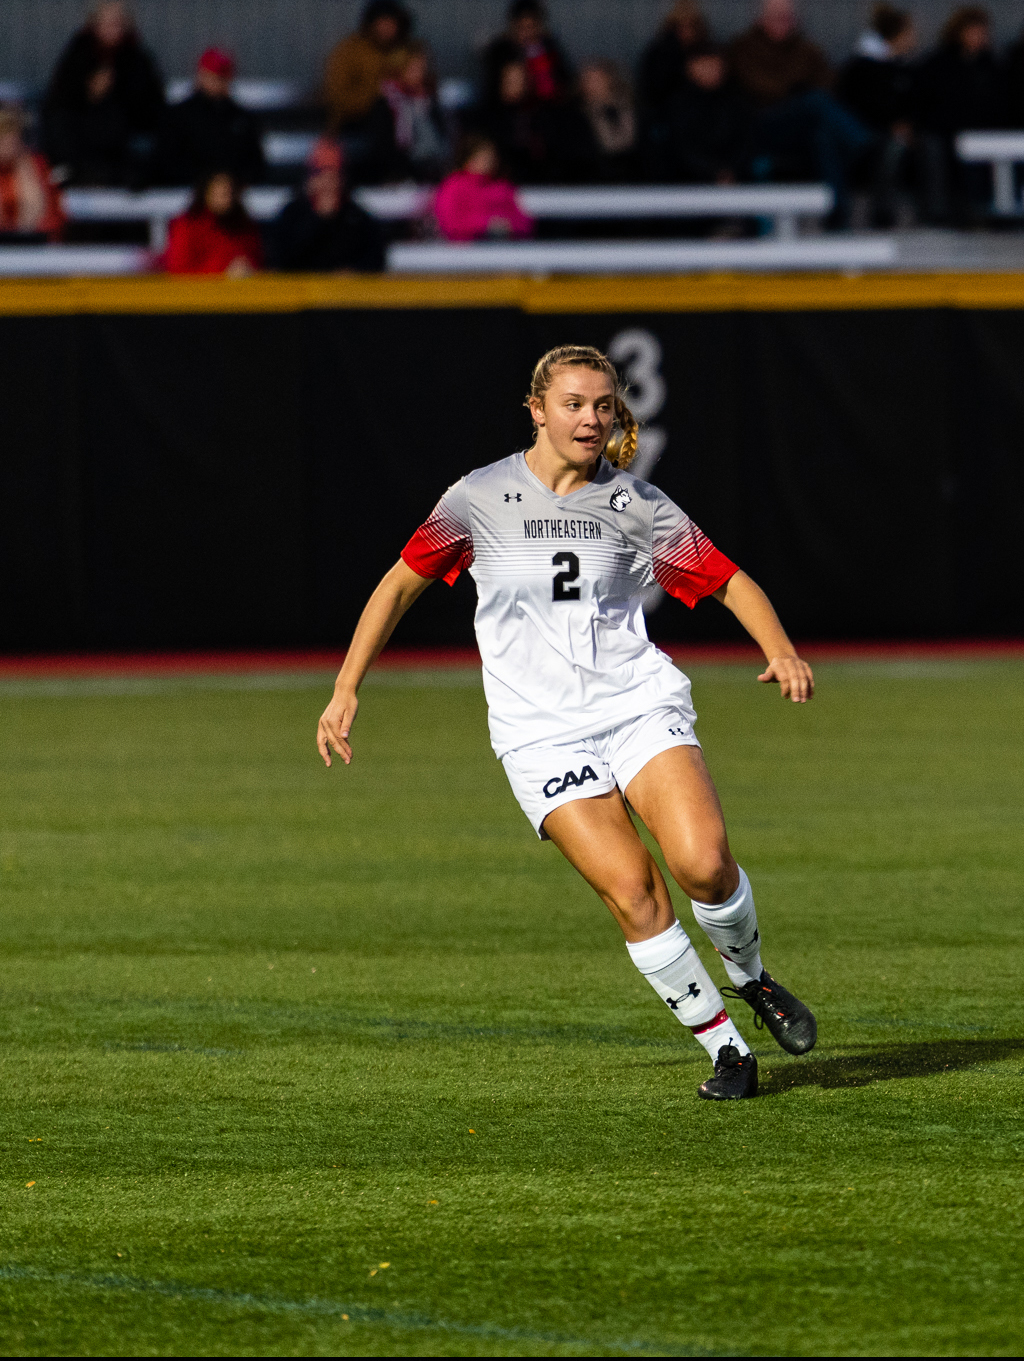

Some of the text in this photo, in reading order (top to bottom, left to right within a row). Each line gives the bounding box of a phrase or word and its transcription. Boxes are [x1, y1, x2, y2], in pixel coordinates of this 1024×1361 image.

[523, 519, 602, 540] NORTHEASTERN
[551, 551, 581, 602] 2
[542, 764, 599, 799] CAA
